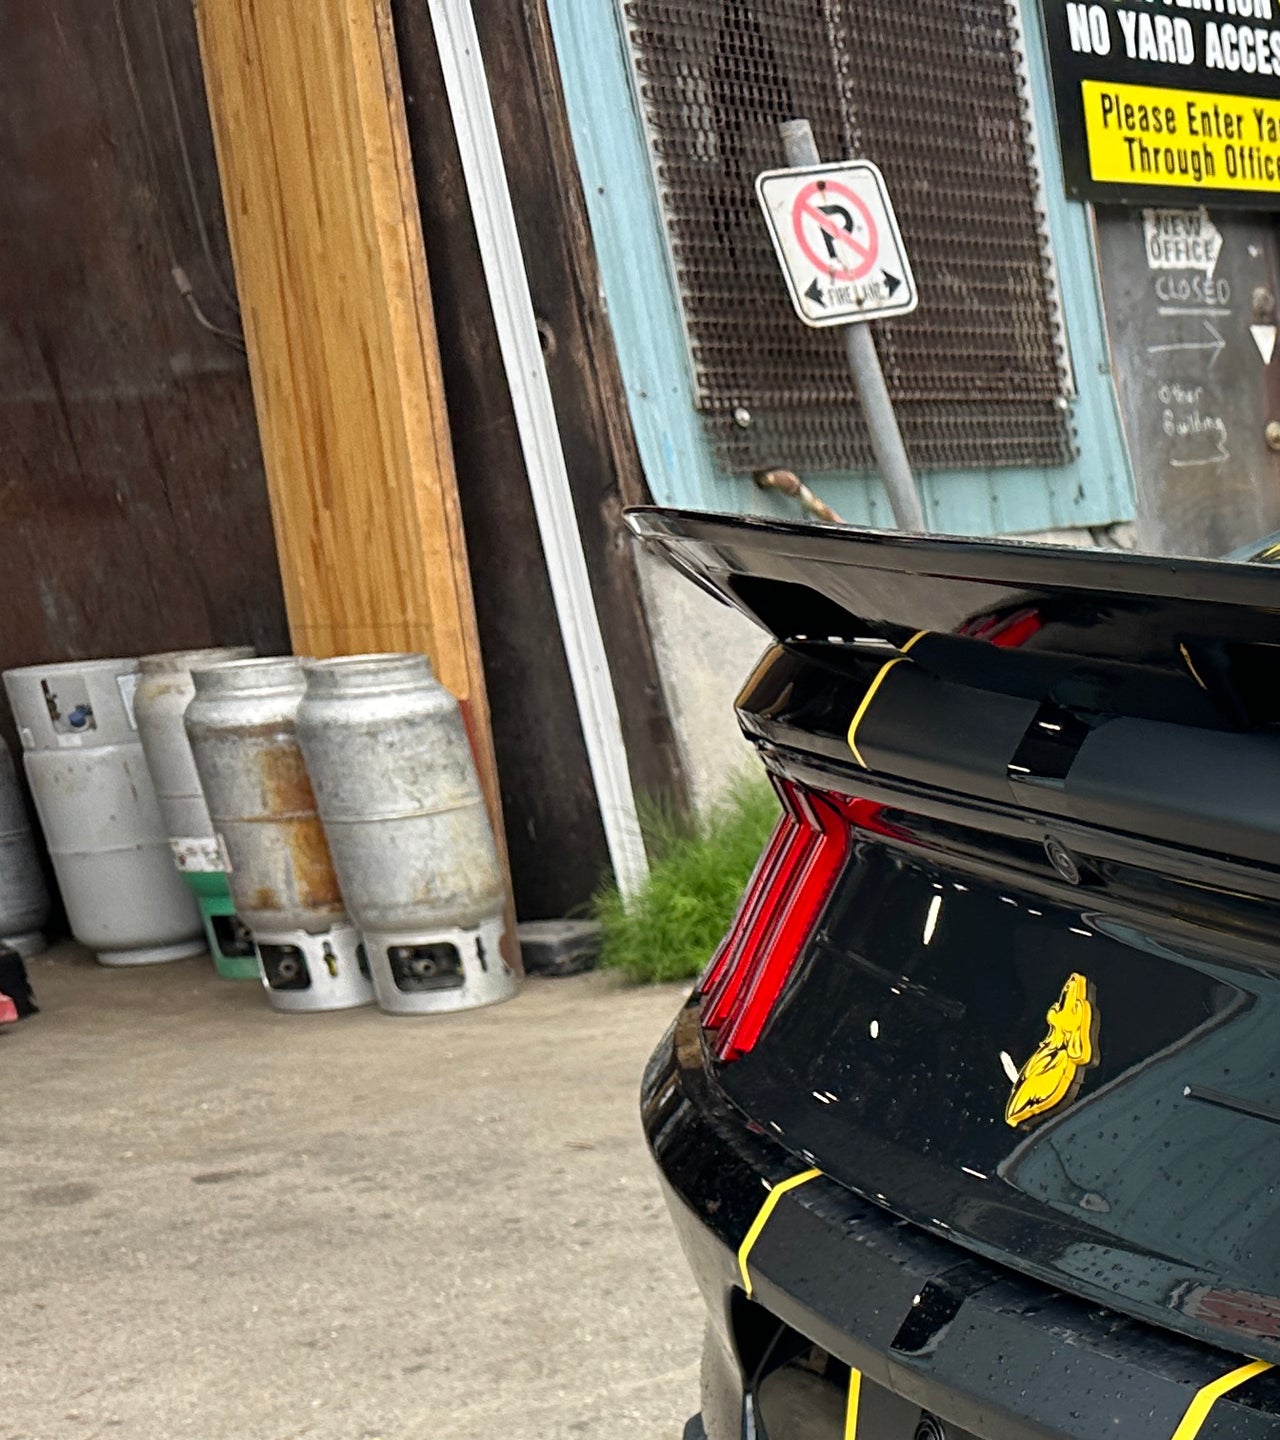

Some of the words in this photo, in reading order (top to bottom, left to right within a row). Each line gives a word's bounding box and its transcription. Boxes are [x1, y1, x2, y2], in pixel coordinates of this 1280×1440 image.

[1066, 3, 1111, 55] NO
[1117, 9, 1195, 65] YARD
[1100, 93, 1177, 134] Please
[1186, 101, 1243, 140] Enter
[1124, 136, 1216, 182] Through
[1150, 236, 1217, 262] OFFICE
[1155, 275, 1231, 305] CLOSED
